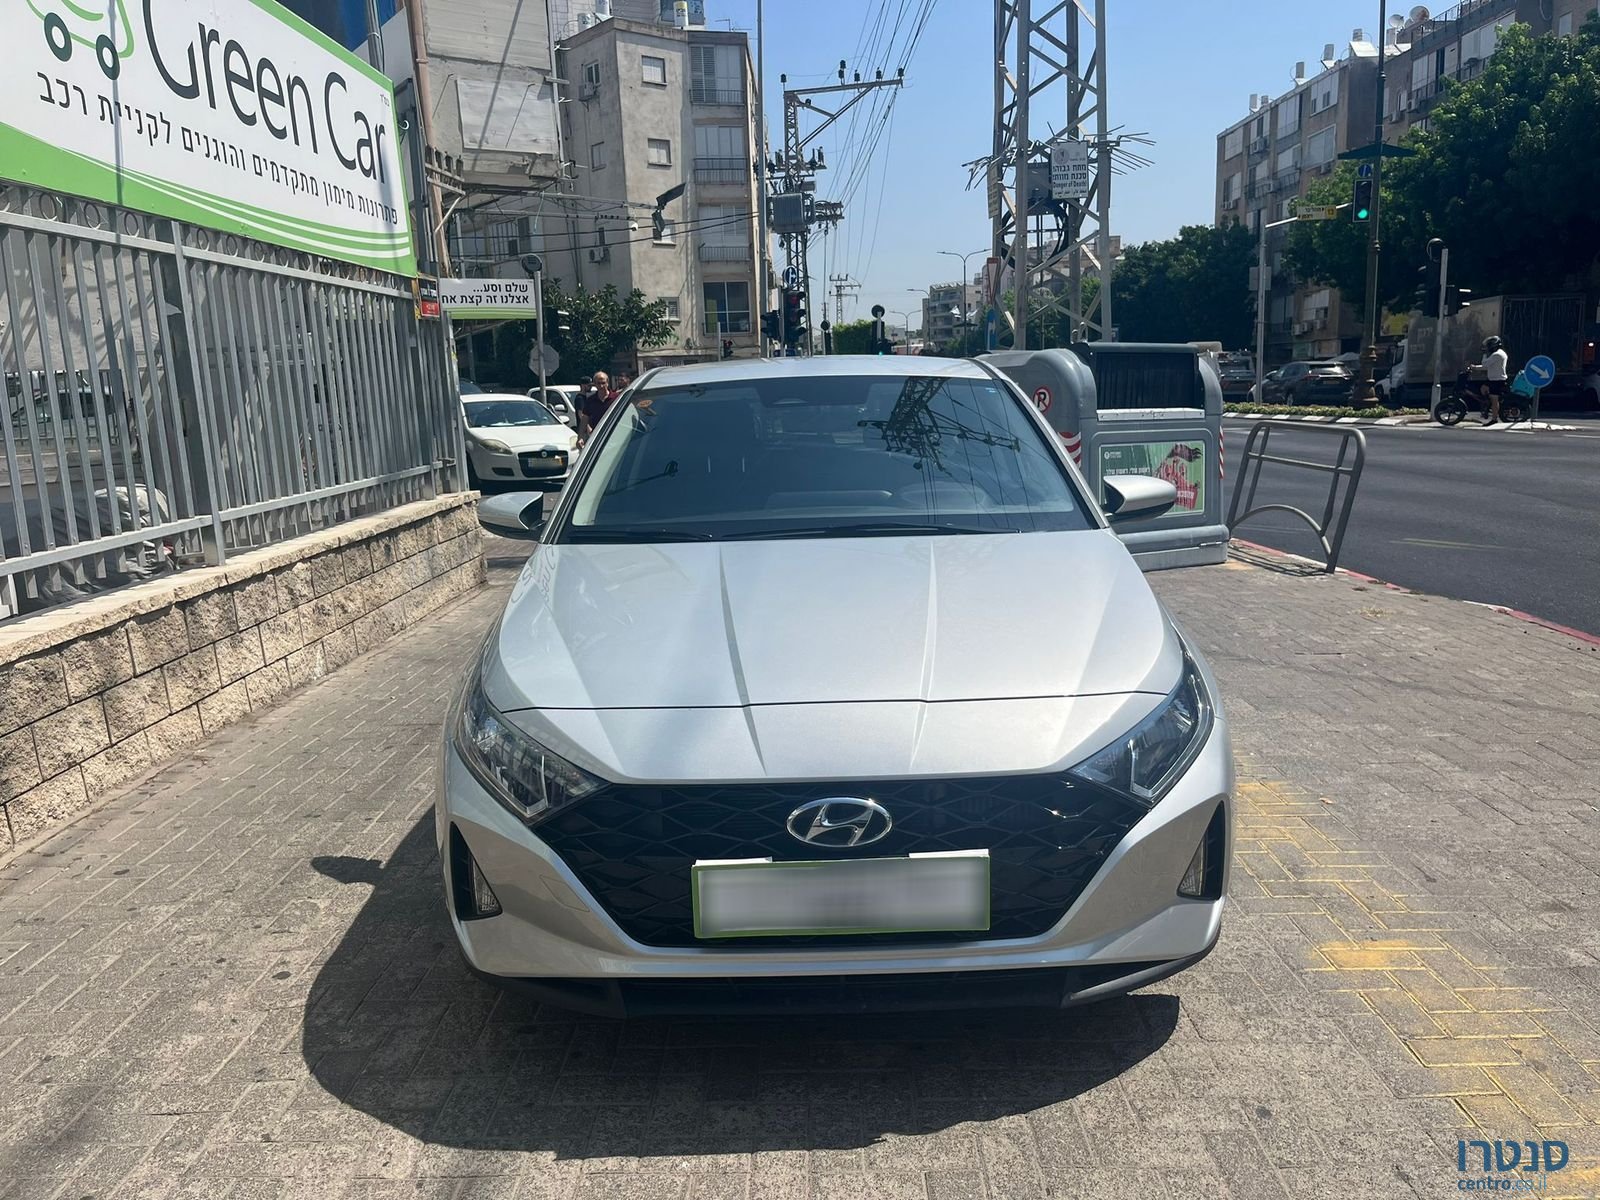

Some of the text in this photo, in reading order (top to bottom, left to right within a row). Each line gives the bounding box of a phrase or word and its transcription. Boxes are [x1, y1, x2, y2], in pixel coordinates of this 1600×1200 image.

[141, 0, 386, 184] Green Car
[36, 71, 398, 225] פתרונות מימון מתקדמים והוגנים לקניית רכב
[473, 282, 528, 292] שלם וסע...
[460, 295, 482, 306] קצת
[486, 295, 498, 304] זה
[501, 293, 529, 304] אצלנו
